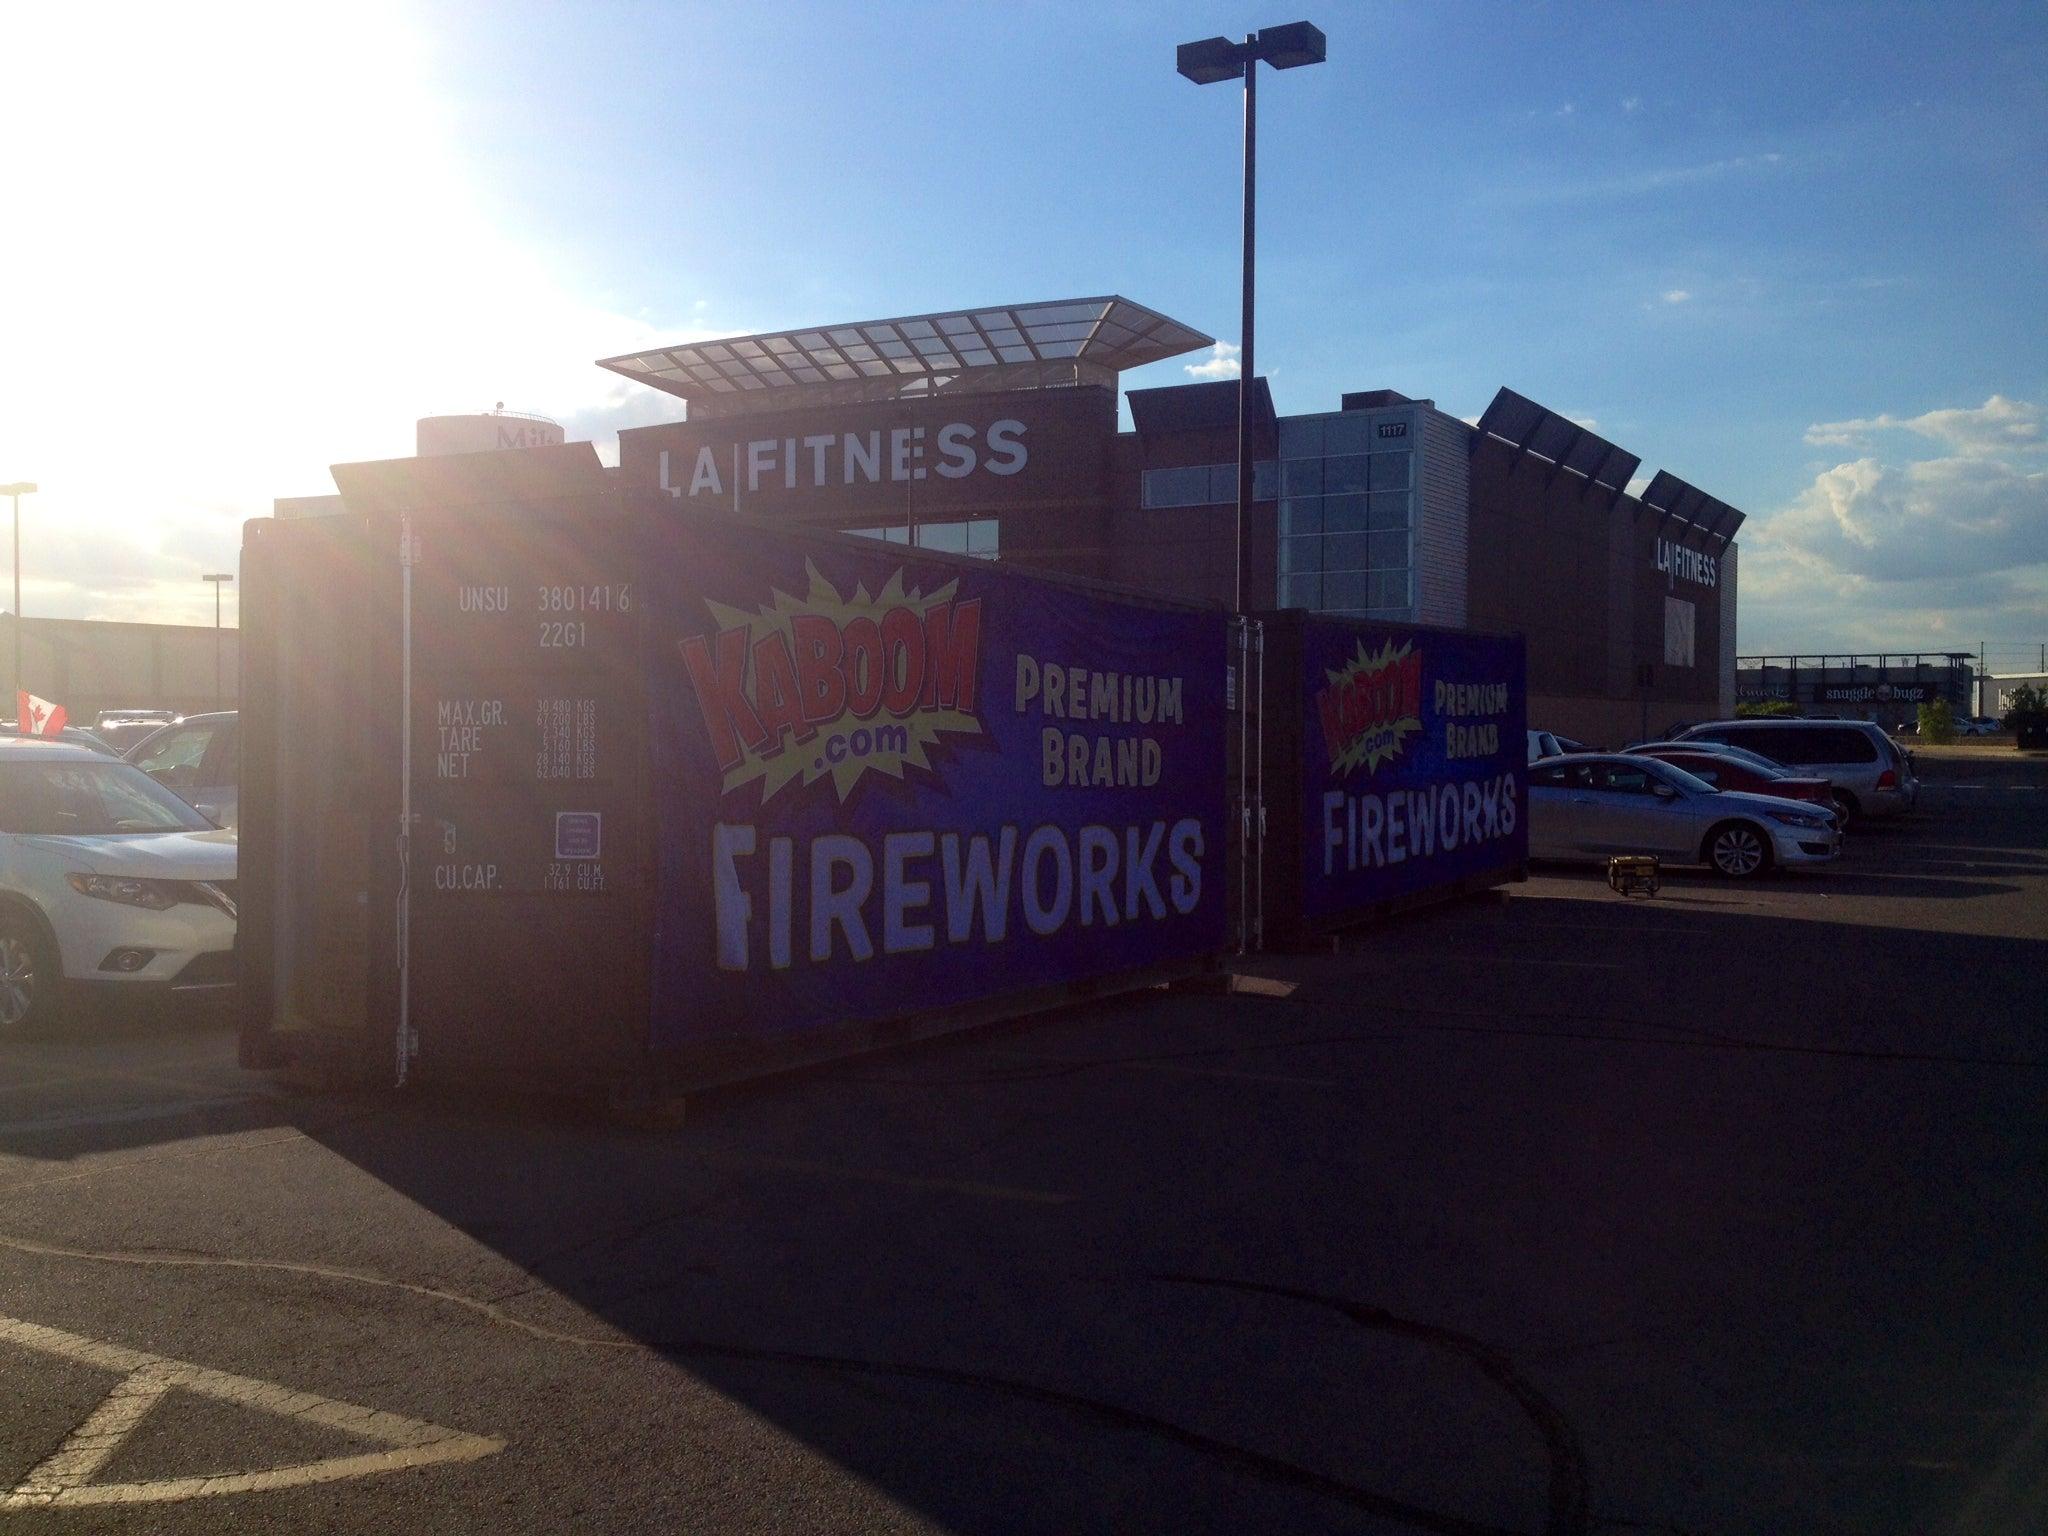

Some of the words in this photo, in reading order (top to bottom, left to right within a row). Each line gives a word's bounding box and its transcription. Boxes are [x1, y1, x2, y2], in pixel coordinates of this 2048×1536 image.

[1380, 424, 1405, 437] 1117
[659, 446, 723, 498] LA
[747, 419, 1028, 492] FITNESS
[1657, 537, 1671, 574] LA
[1675, 544, 1716, 588] FITNESS
[459, 587, 509, 611] UNSU
[539, 622, 587, 648] 22G1
[678, 597, 982, 770] KABOOM
[1015, 653, 1184, 725] PREMIUM
[1826, 687, 1875, 703] snuggle
[1892, 686, 1924, 703] bugz
[576, 700, 596, 712] KGS
[1434, 680, 1509, 717] PREMIUM
[438, 701, 508, 725] MAX.GR.
[576, 713, 596, 725] LBS
[438, 727, 483, 752] TARE
[576, 740, 596, 751] LBS
[813, 722, 908, 771] .com
[1446, 723, 1500, 759] BRAND
[437, 754, 470, 778] NET
[576, 766, 596, 778] LBS
[1041, 734, 1163, 788] BRAND
[1322, 772, 1517, 876] FIREWORKS
[435, 864, 503, 889] CU.CAP.
[712, 816, 1206, 972] FIREWORKS
